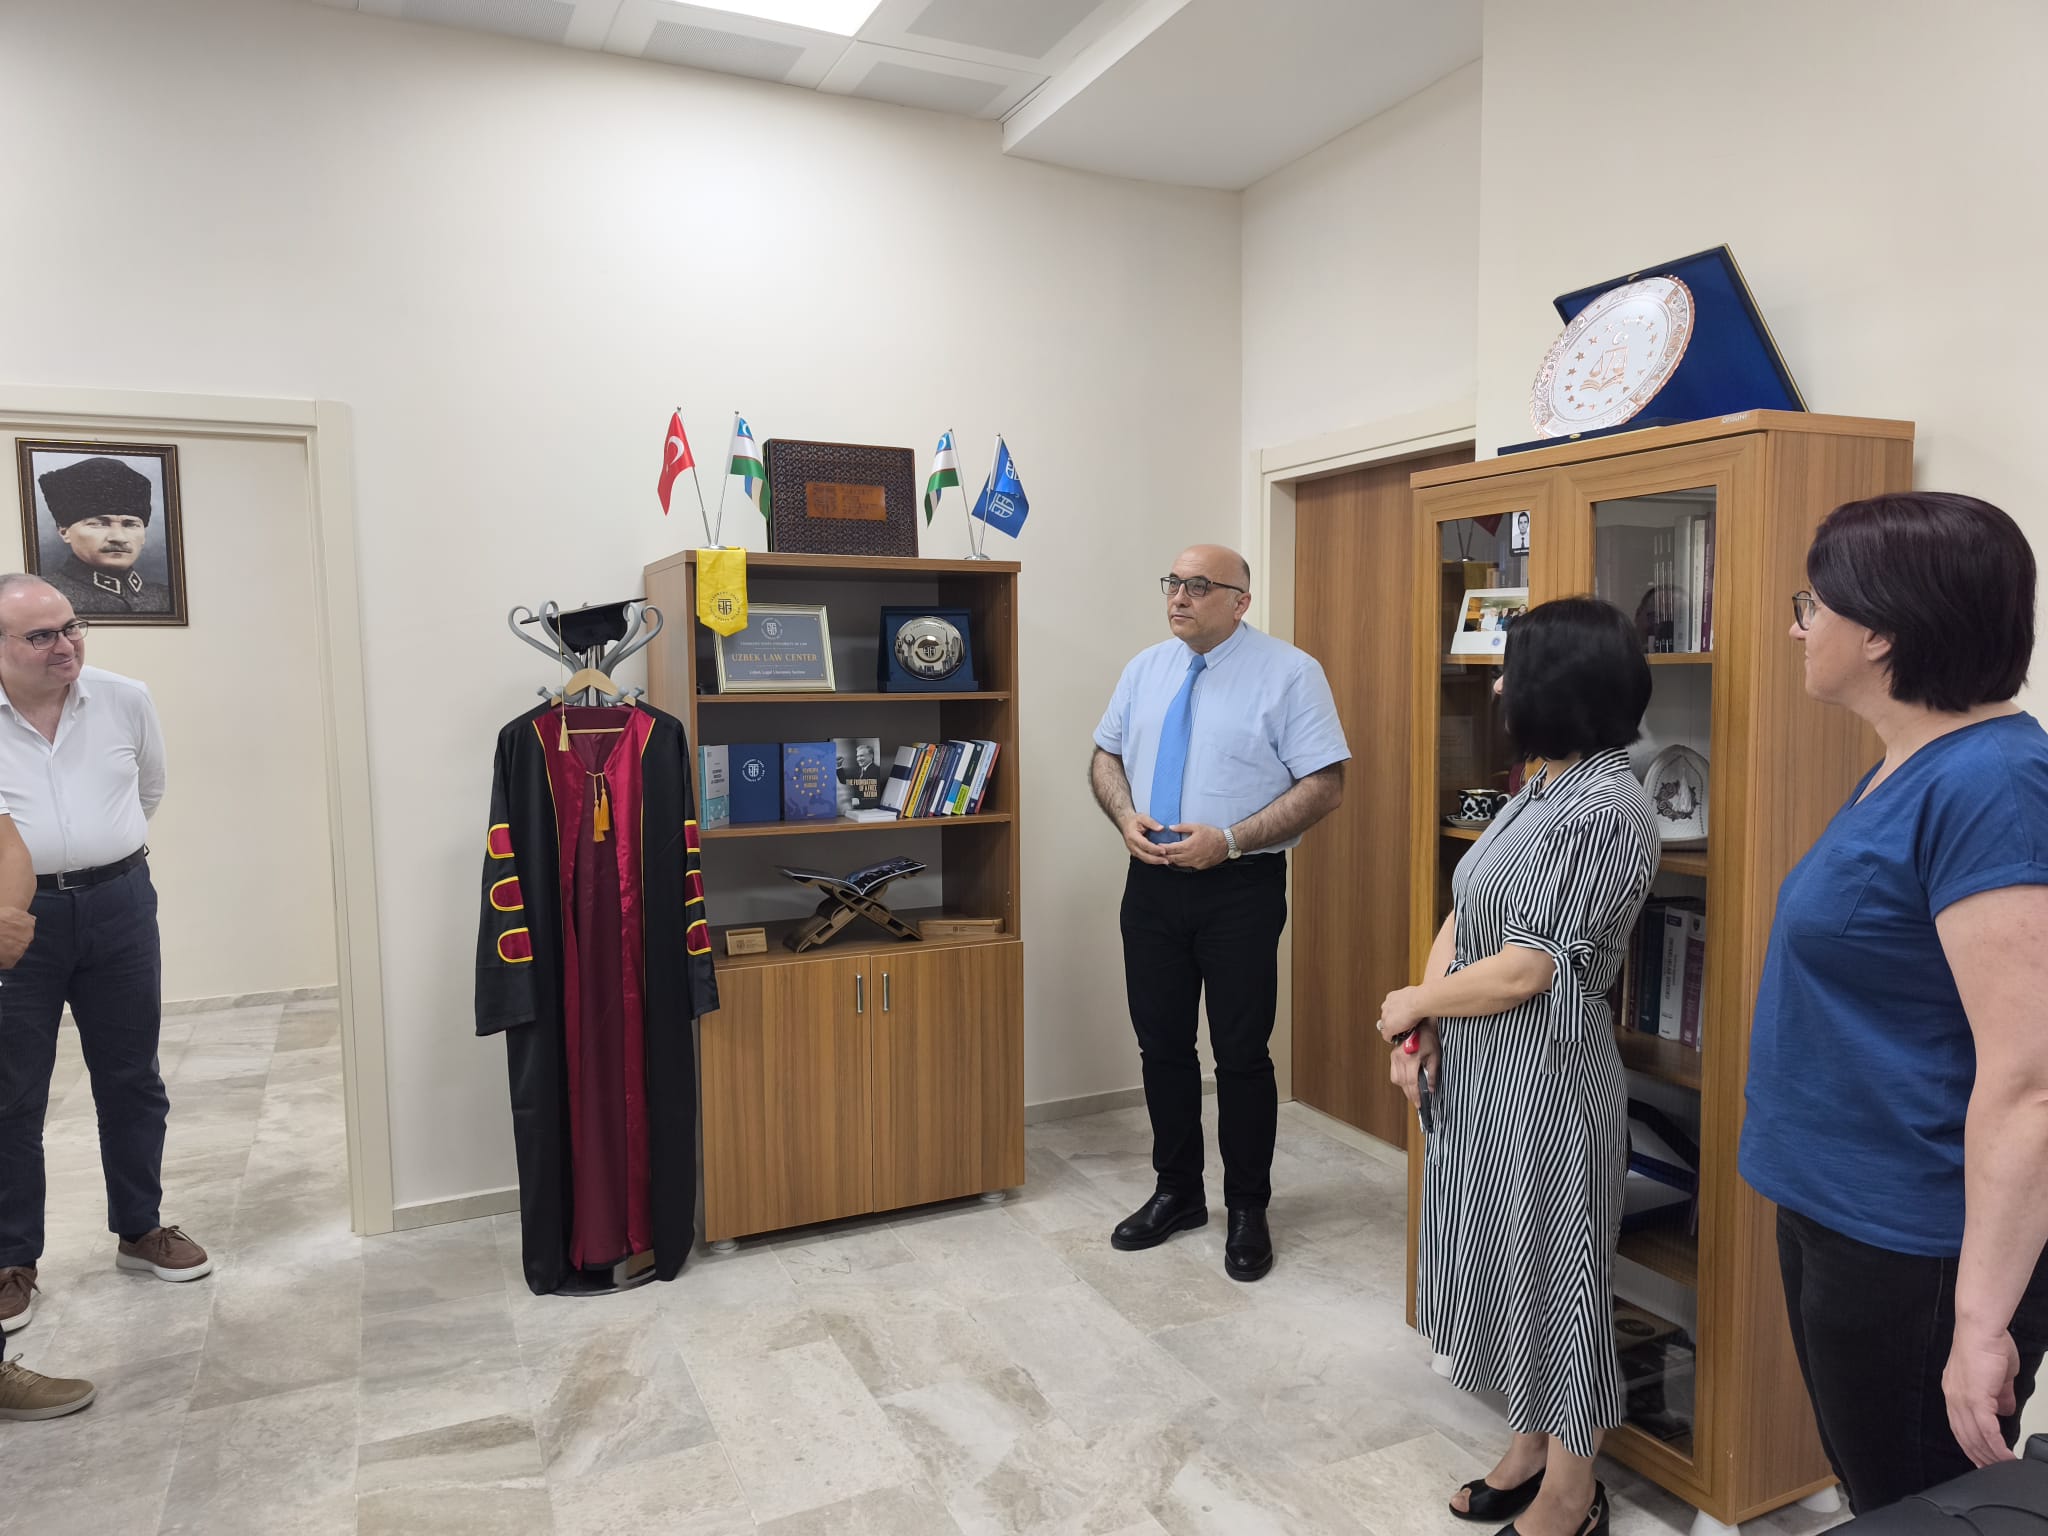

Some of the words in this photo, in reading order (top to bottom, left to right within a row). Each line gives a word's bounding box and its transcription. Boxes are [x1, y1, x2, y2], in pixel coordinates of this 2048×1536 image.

[732, 653, 761, 662] UZBEK
[763, 653, 783, 662] LAW
[785, 653, 817, 662] CENTER
